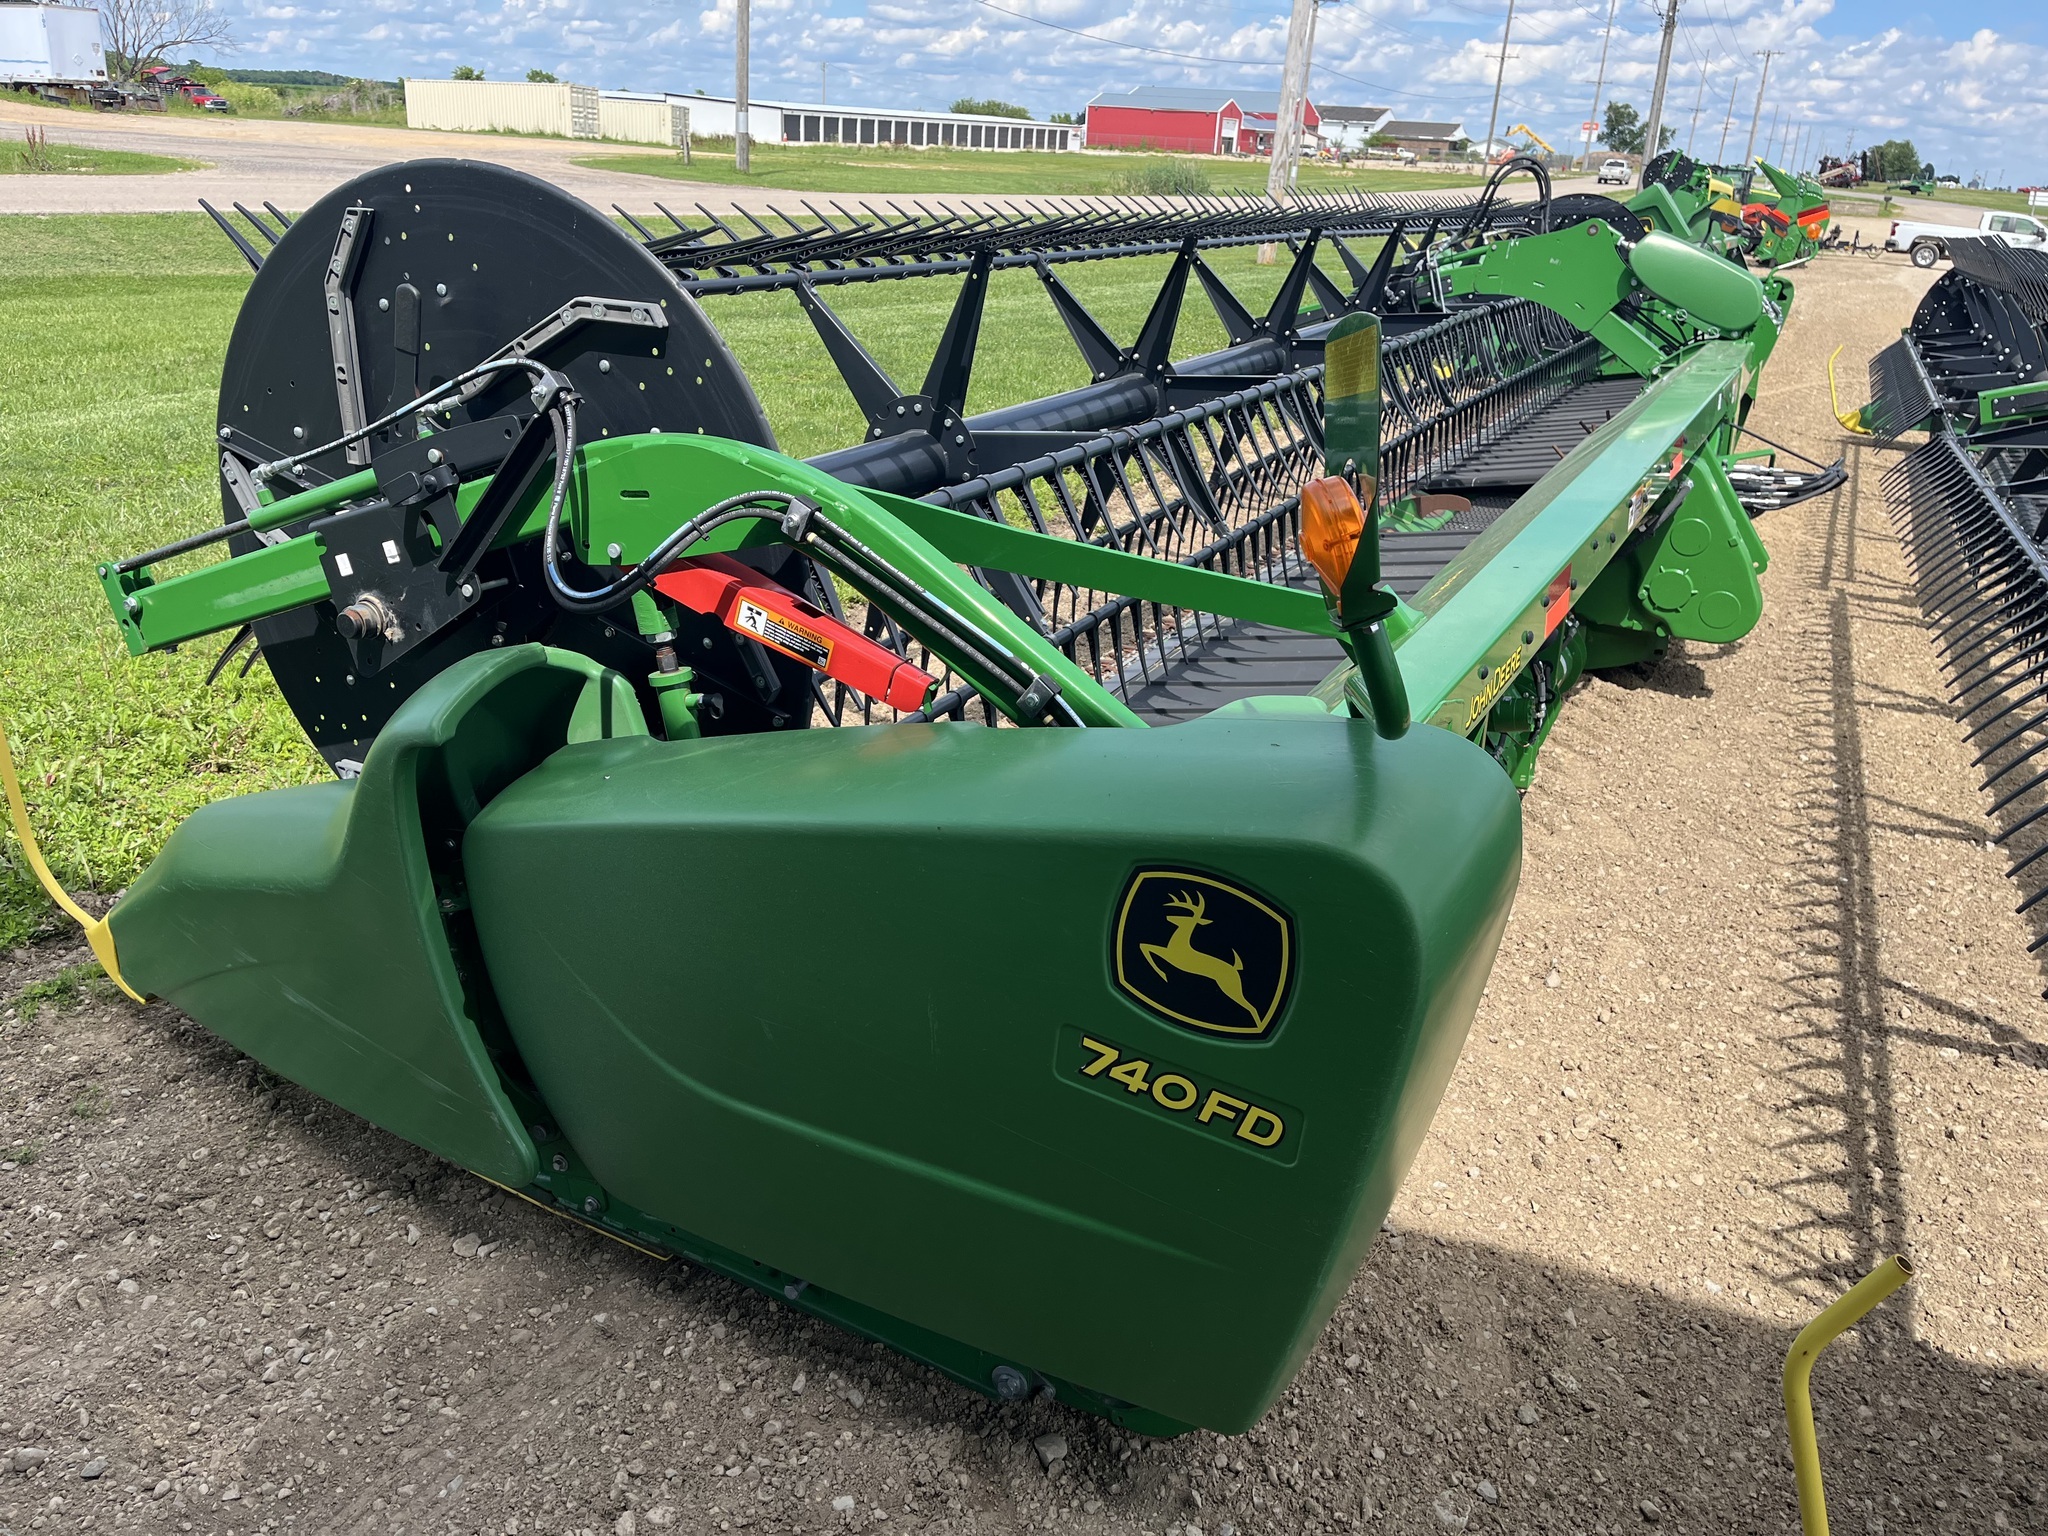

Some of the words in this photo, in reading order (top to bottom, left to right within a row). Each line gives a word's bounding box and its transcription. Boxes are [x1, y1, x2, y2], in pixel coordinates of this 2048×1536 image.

[787, 621, 824, 645] WARNING
[1465, 679, 1494, 728] JOHN
[1493, 646, 1522, 698] DEERE
[1081, 1036, 1285, 1148] 740FD
